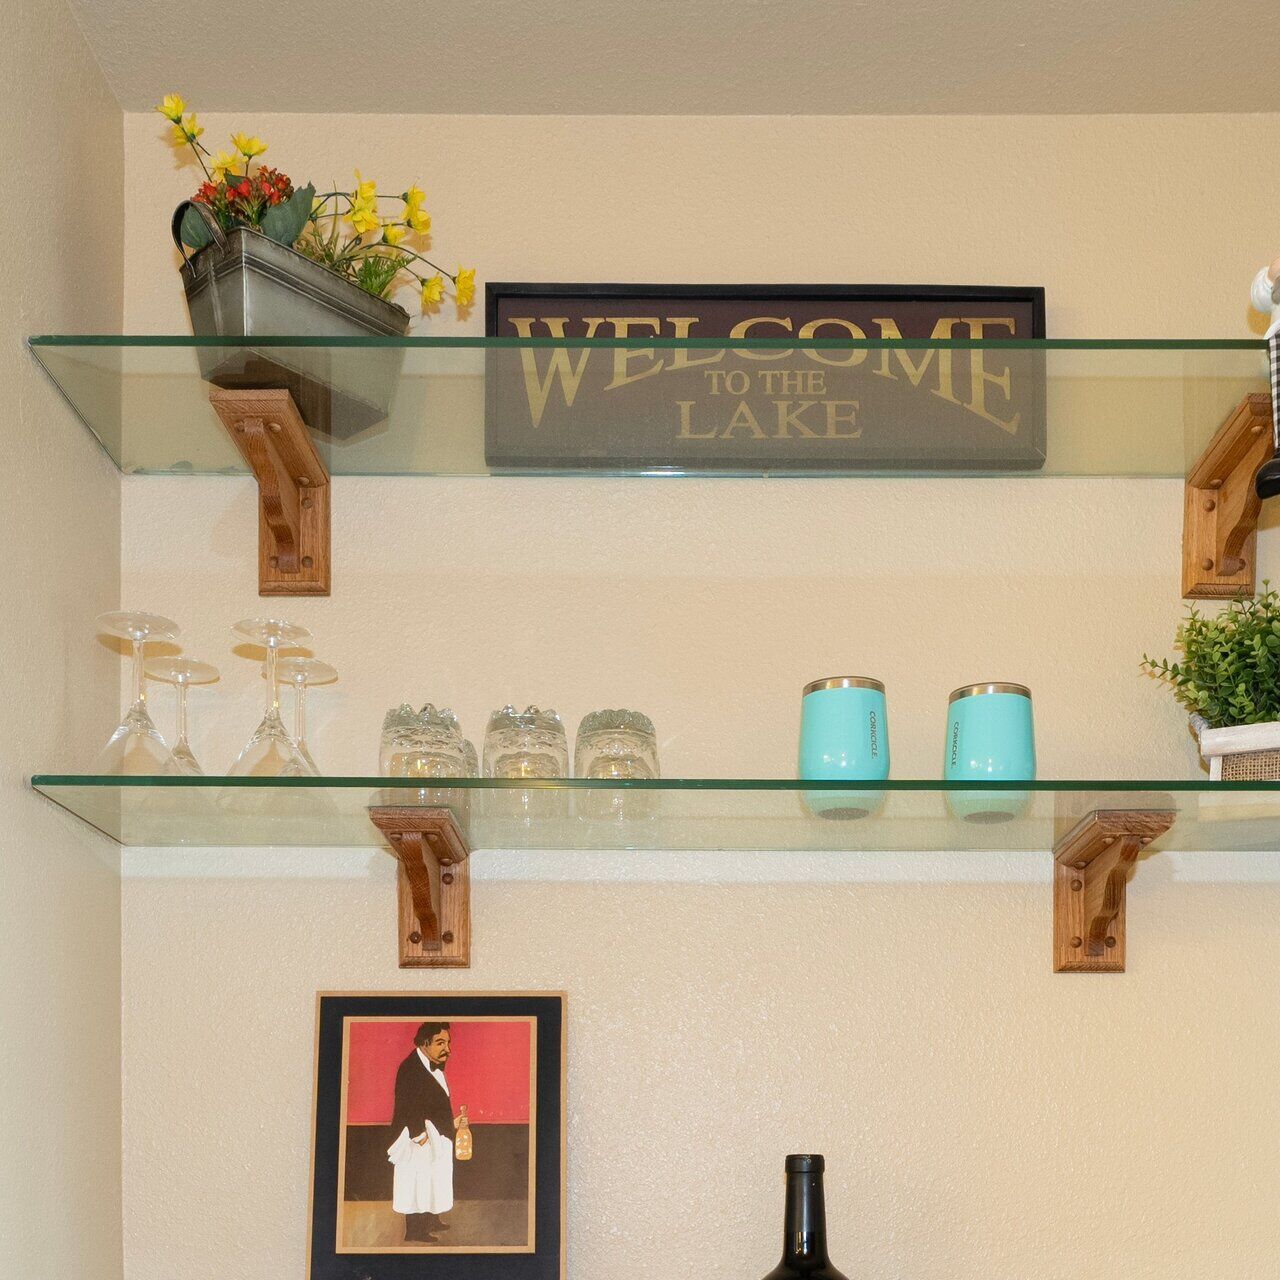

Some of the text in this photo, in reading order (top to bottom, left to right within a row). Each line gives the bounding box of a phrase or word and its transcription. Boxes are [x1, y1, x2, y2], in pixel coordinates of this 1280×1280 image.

[508, 317, 1018, 436] WELCOME
[704, 370, 827, 395] TO THE
[675, 400, 863, 439] LAKE
